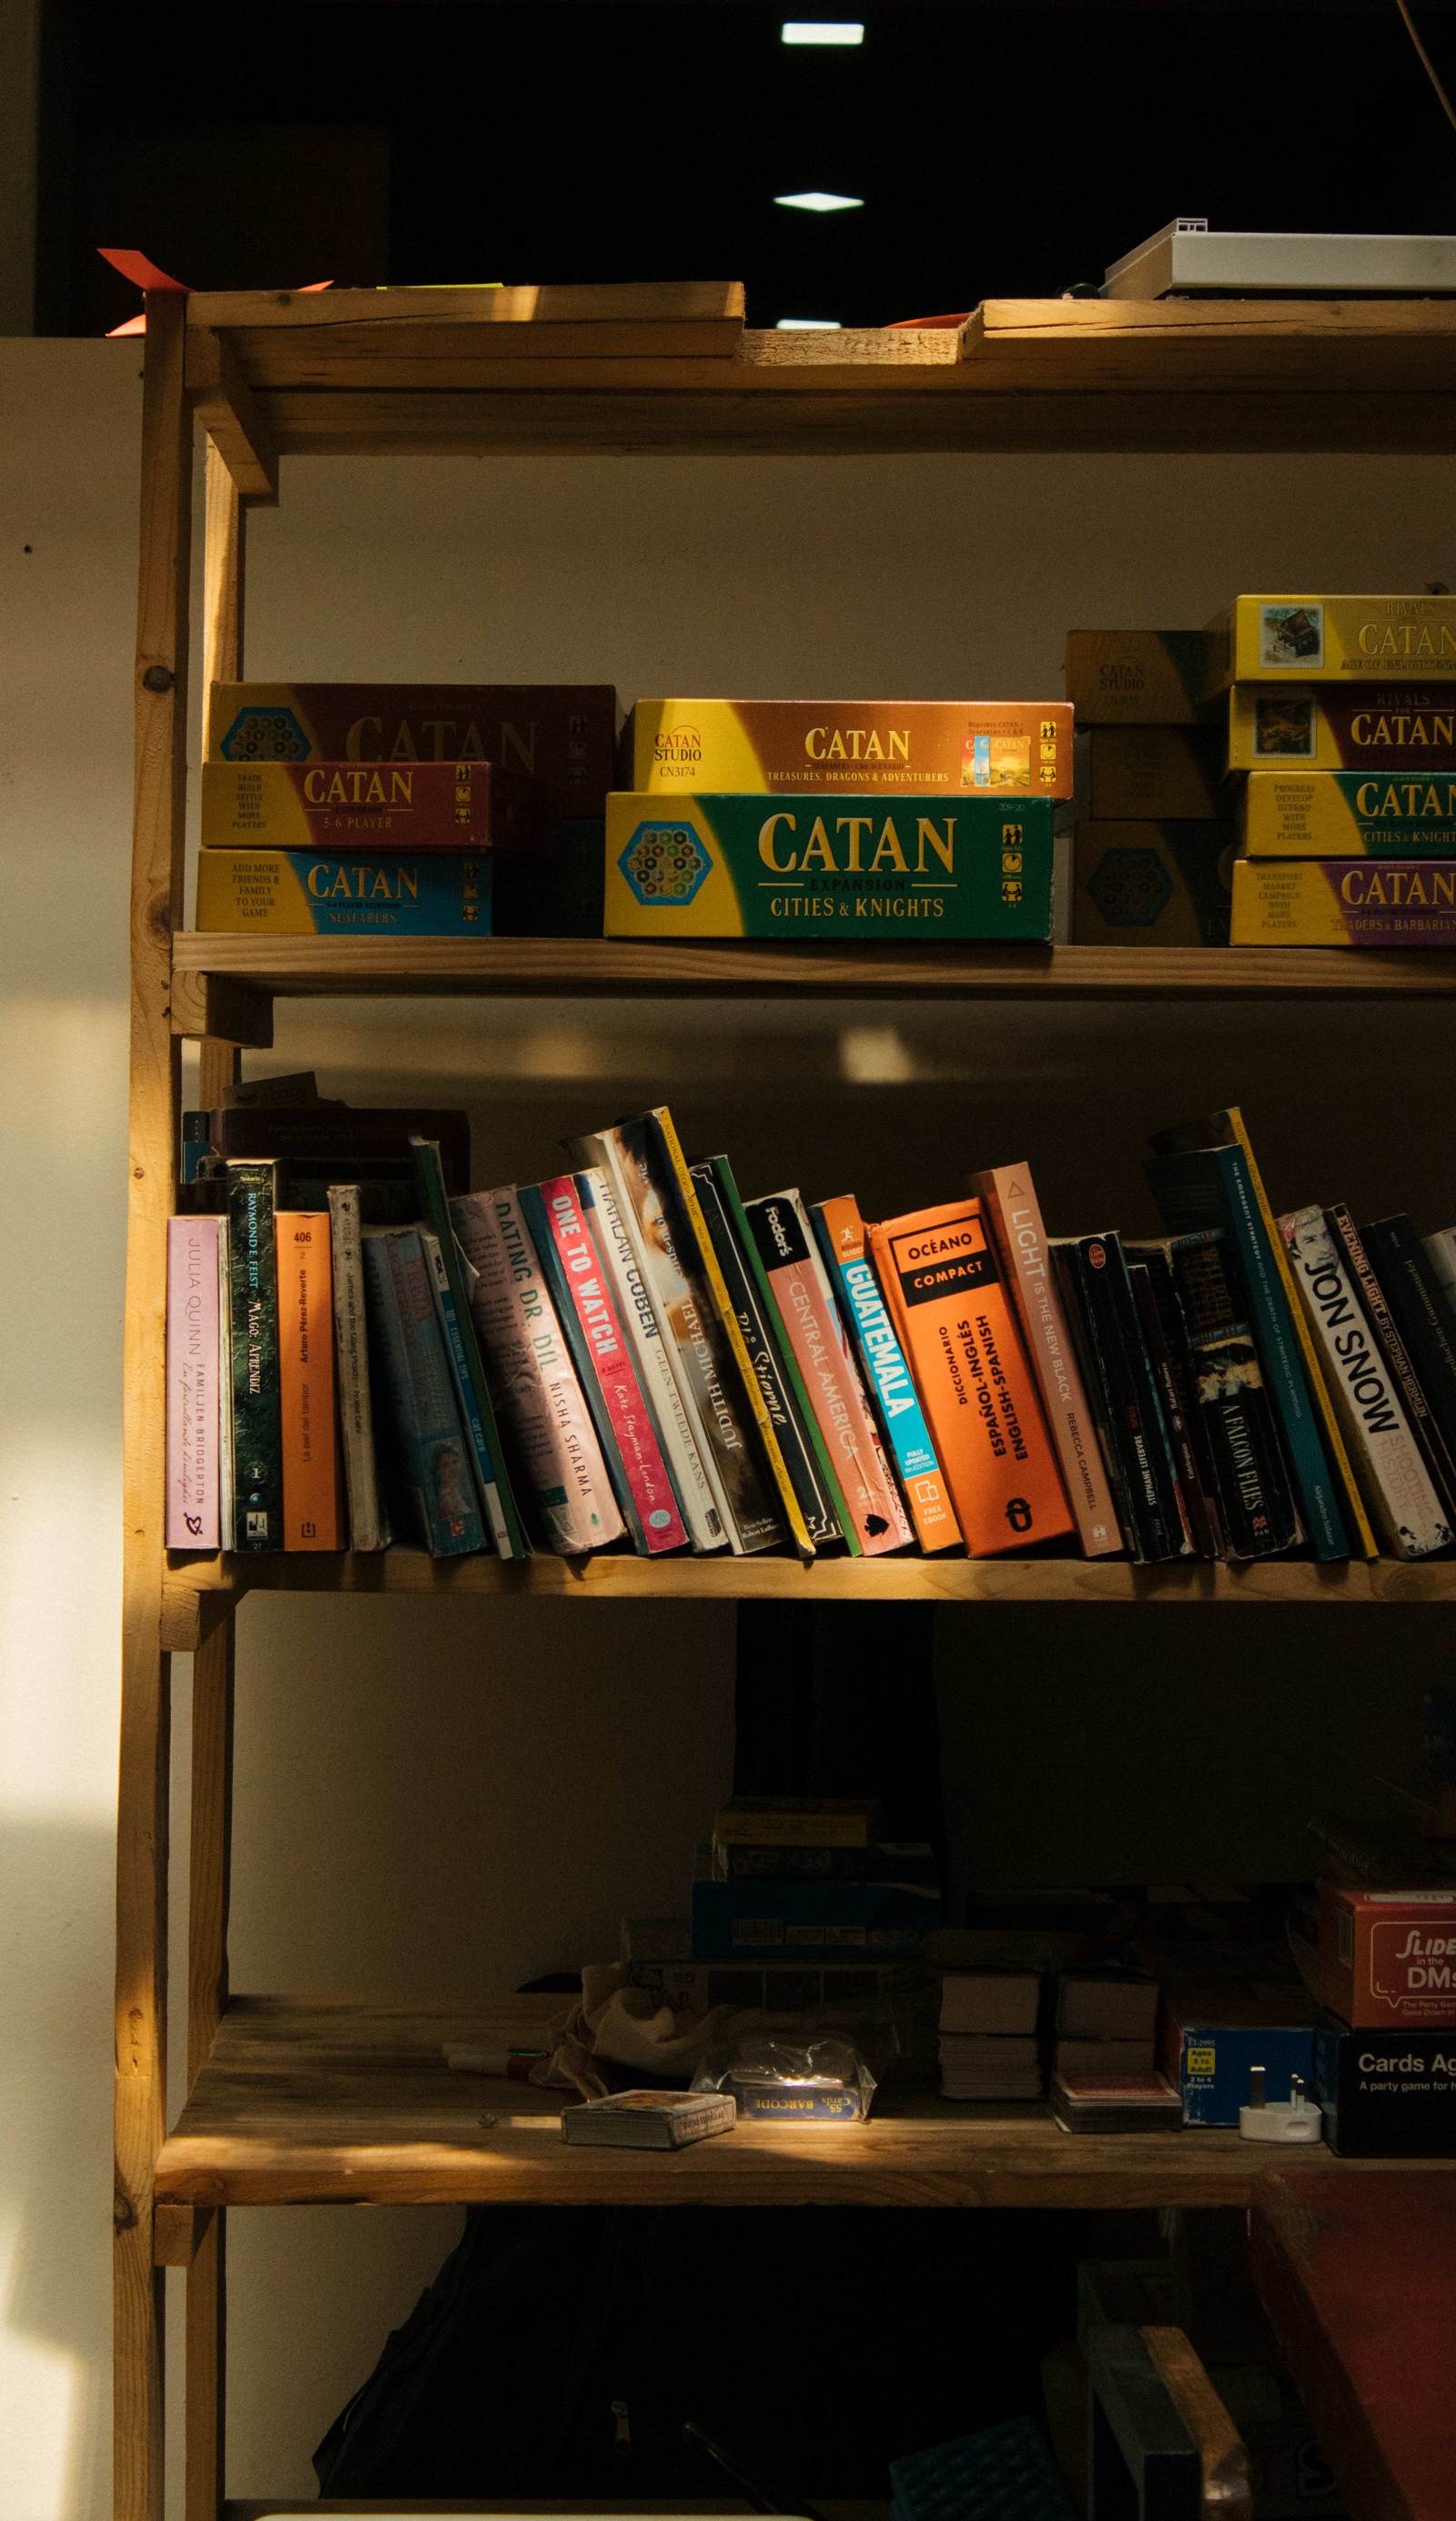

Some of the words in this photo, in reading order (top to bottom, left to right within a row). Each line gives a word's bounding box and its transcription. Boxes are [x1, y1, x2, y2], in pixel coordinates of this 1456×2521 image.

[1358, 623, 1456, 655] CATAN
[1100, 663, 1144, 678] CATAN
[1100, 678, 1144, 691] STUDIO
[1376, 693, 1431, 706] RIVALS
[345, 714, 540, 774] CATAN
[654, 733, 702, 748] CATAN
[804, 727, 911, 762] CATAN
[1350, 714, 1455, 746] CATAN
[654, 748, 702, 763] STUDIO
[660, 765, 697, 777] CN3174
[304, 769, 415, 805] CATAN
[767, 771, 823, 782] TREASURES,
[826, 771, 870, 782] DRAGONS
[872, 772, 878, 782] &
[882, 772, 949, 783] ADVENTURERS
[323, 817, 343, 829] 5-6
[348, 816, 392, 830] PLAYER
[1363, 831, 1400, 843] CITIES
[757, 812, 958, 874] CATAN
[232, 864, 253, 874] ADD
[254, 864, 279, 874] MORE
[232, 874, 271, 885] FRIENDS
[307, 863, 419, 900] CATAN
[809, 878, 905, 892] EXPANSION
[237, 896, 248, 906] TO
[250, 896, 276, 906] YOUR
[239, 886, 271, 895] FAMILY
[1341, 870, 1455, 905] CATAN
[242, 908, 268, 918] GAME
[770, 896, 834, 917] CITIES
[839, 899, 850, 917] &
[854, 897, 945, 919] KNIGHTS
[665, 1123, 682, 1165] NATIONAL
[1231, 1161, 1240, 1177] THE
[247, 1192, 258, 1248] RAYMOND
[552, 1195, 581, 1239] ONE
[765, 1206, 792, 1258] Fodor's
[294, 1232, 312, 1243] 406
[907, 1231, 974, 1262] OCÉANO
[1012, 1209, 1045, 1277] LIGHT
[187, 1238, 201, 1289] JULIA
[567, 1242, 592, 1272] TO
[249, 1260, 259, 1290] FEIST
[496, 1202, 532, 1282] DATING
[520, 1290, 543, 1321] DR
[532, 1334, 558, 1371] DIL
[913, 1259, 985, 1290] COMPACT
[1034, 1282, 1046, 1294] IS
[1037, 1297, 1052, 1322] THE
[1339, 1214, 1370, 1274] EVENING
[1380, 1318, 1391, 1332] BY
[1386, 1331, 1412, 1377] STEPHAN
[187, 1295, 203, 1355] QUINN
[578, 1278, 619, 1355] WATCH
[299, 1334, 308, 1362] Arturo
[681, 1298, 718, 1382] MICHAEL
[843, 1263, 908, 1419] GUATEMALA
[1045, 1324, 1061, 1356] NEW
[1304, 1262, 1356, 1329] JON
[1334, 1330, 1400, 1434] SNOW
[248, 1343, 261, 1394] APRENDIZ
[789, 1281, 829, 1368] CENTRAL
[817, 1369, 861, 1460] AMERICA
[939, 1325, 969, 1406] DICCIONARIO
[1051, 1359, 1072, 1403] BLACK
[196, 1363, 204, 1422] FAMILJEN
[301, 1382, 310, 1413] tambor
[958, 1319, 1006, 1458] ESPAÑOL-INGLÉS
[976, 1315, 1028, 1461] ENGLISH-SPANISH
[301, 1417, 309, 1431] del
[707, 1383, 743, 1451] JUDITH
[301, 1433, 310, 1449] piel
[549, 1382, 571, 1429] NISHA
[565, 1434, 592, 1496] SHARMA
[614, 1384, 628, 1411] Kate
[623, 1414, 656, 1503] Stayman-London
[1224, 1415, 1255, 1469] FALCON
[196, 1428, 205, 1505] BRIDGERTON
[302, 1452, 309, 1462] La
[688, 1449, 706, 1490] KANS
[1067, 1412, 1085, 1459] REBECCA
[1079, 1459, 1098, 1511] CAMPBELL
[1238, 1470, 1265, 1511] FLIES
[924, 1506, 942, 1516] FREE
[924, 1514, 947, 1525] EBOOK
[1396, 1929, 1456, 1959] SLIDE
[1416, 1957, 1426, 1966] in
[1428, 1957, 1445, 1966] the
[1359, 2053, 1425, 2073] Cards
[1360, 2081, 1368, 2091] A
[1370, 2081, 1400, 2093] party
[1401, 2082, 1430, 2093] game
[1432, 2081, 1448, 2091] for
